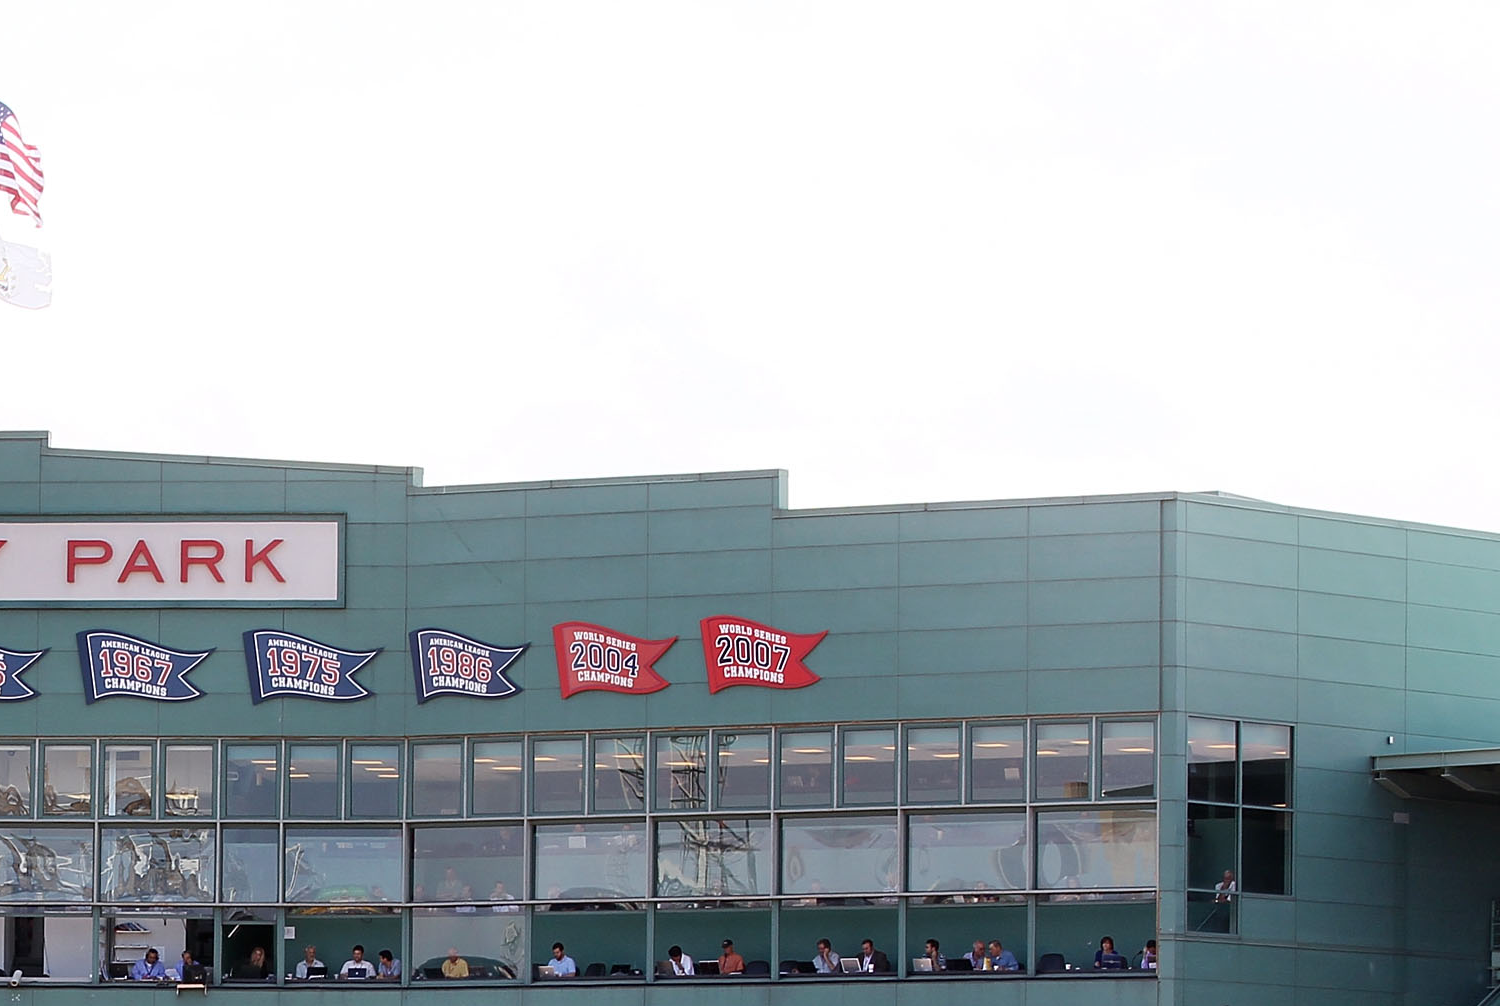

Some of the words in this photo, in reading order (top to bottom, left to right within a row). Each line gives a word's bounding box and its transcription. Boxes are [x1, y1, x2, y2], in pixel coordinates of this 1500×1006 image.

[66, 538, 286, 583] PARK
[573, 631, 605, 644] WORLD
[605, 636, 636, 651] SERIES
[718, 624, 753, 636] WORLD
[753, 629, 787, 645] SERIES
[100, 640, 140, 653] AMERICAN
[141, 647, 170, 661] LEAGUE
[267, 639, 307, 652] AMERICAN
[308, 646, 338, 660] LEAGUE
[429, 638, 463, 650] AMERICAN
[464, 644, 490, 658] LEAGUE
[715, 634, 791, 672] 2007
[99, 648, 173, 686] 1967
[266, 647, 341, 686] 1975
[427, 646, 493, 683] 1986
[569, 641, 639, 678] 2004
[432, 675, 487, 693] CHAMPIONS
[577, 670, 634, 688] CHAMPIONS
[723, 666, 784, 684] CHAMPIONS
[104, 678, 167, 697] CHAMPIONS
[271, 677, 335, 696] CHAMPIONS
